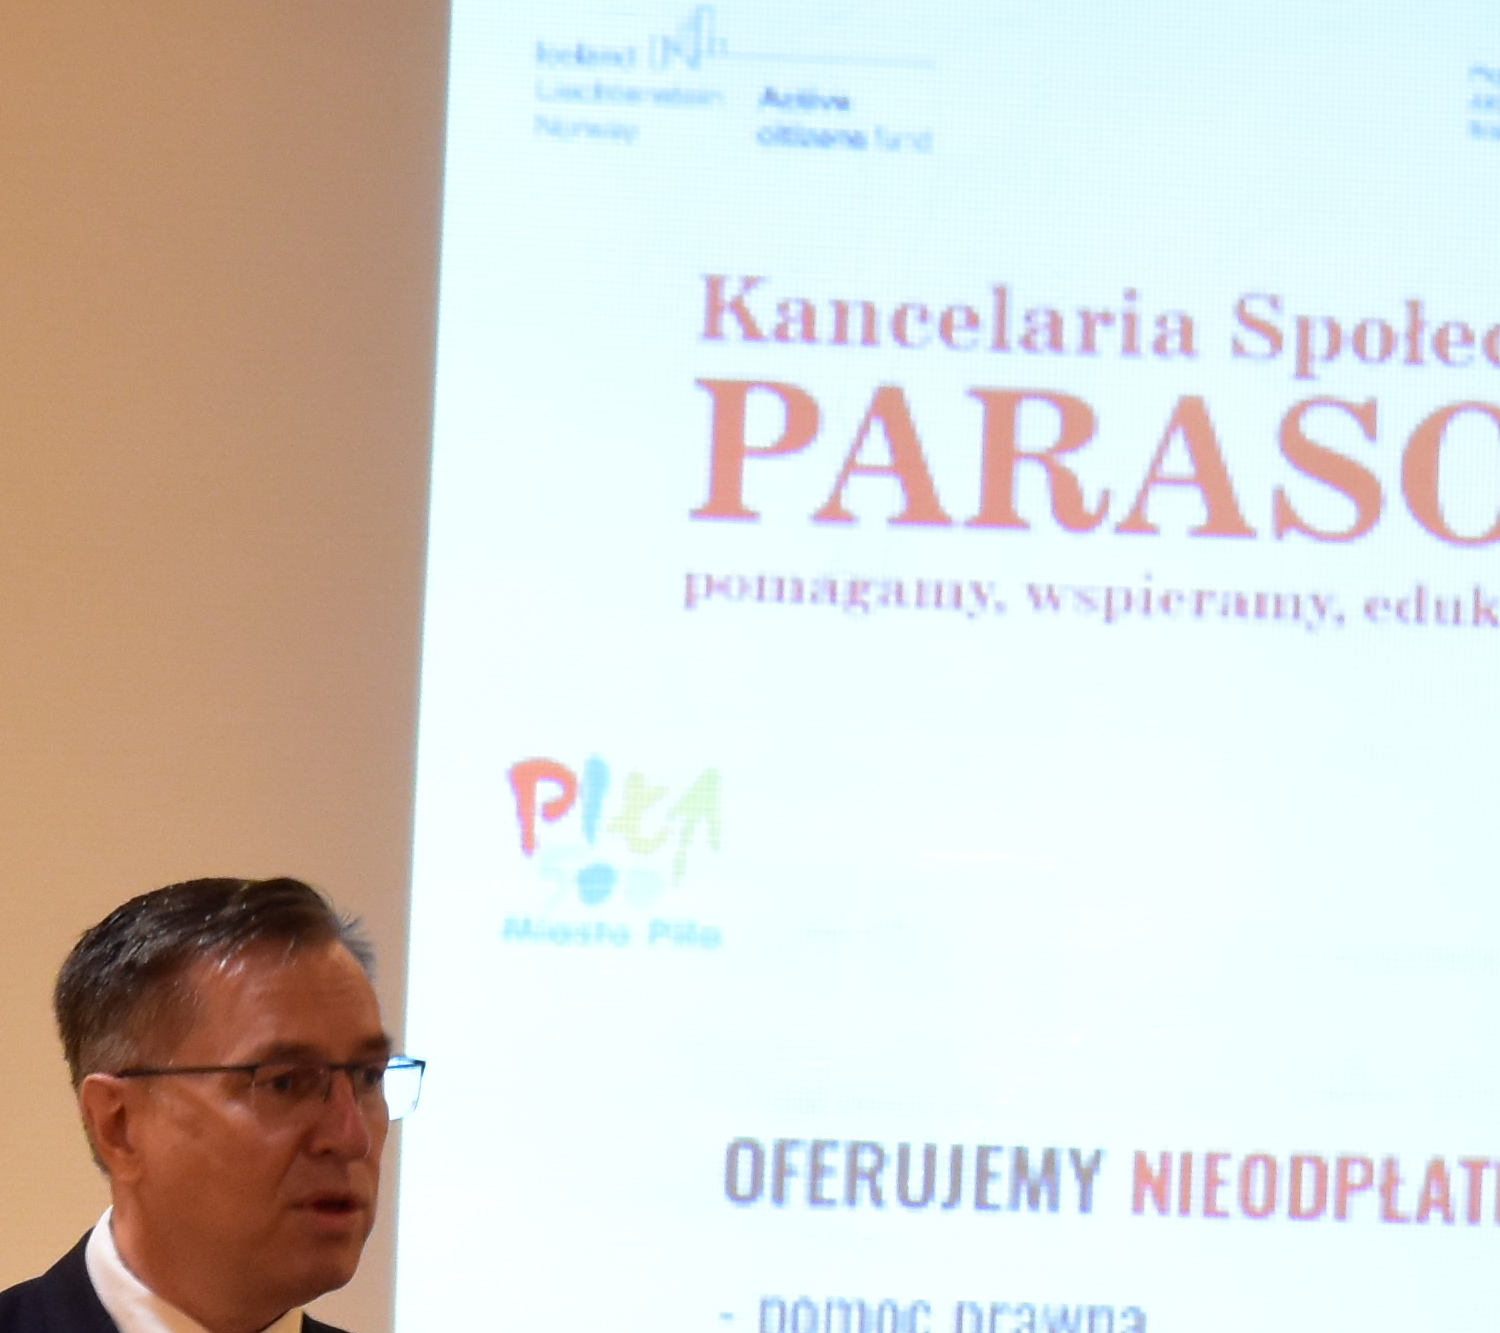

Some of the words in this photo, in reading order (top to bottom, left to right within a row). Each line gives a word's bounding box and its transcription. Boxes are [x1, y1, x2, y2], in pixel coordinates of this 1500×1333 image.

[699, 274, 1198, 361] Kancelaria
[684, 569, 1005, 616] pomagamy,
[1026, 573, 1344, 629] wspieramy,
[723, 1137, 1106, 1215] OFERUJEMY
